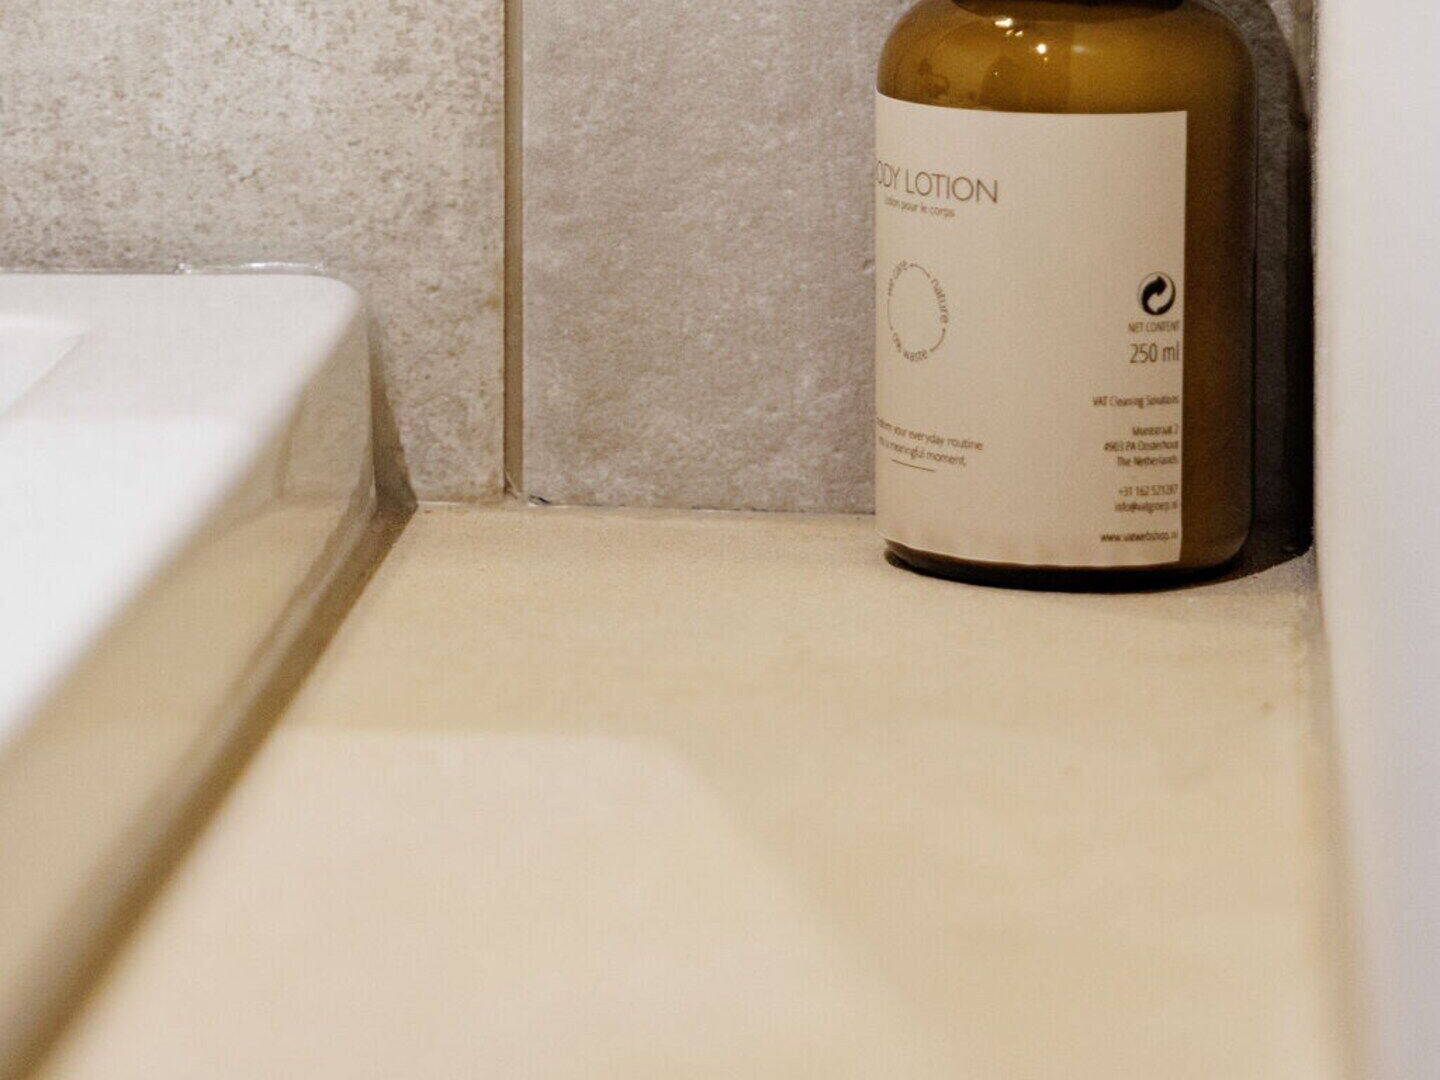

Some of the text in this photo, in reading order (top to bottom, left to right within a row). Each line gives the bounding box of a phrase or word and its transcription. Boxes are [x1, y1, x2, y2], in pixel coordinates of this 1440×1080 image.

[876, 161, 998, 204] ODY LOTION
[930, 278, 949, 323] nature
[1128, 321, 1144, 333] NET
[1129, 341, 1180, 364] 250 ml
[908, 430, 945, 446] everyday
[946, 437, 983, 451] routine
